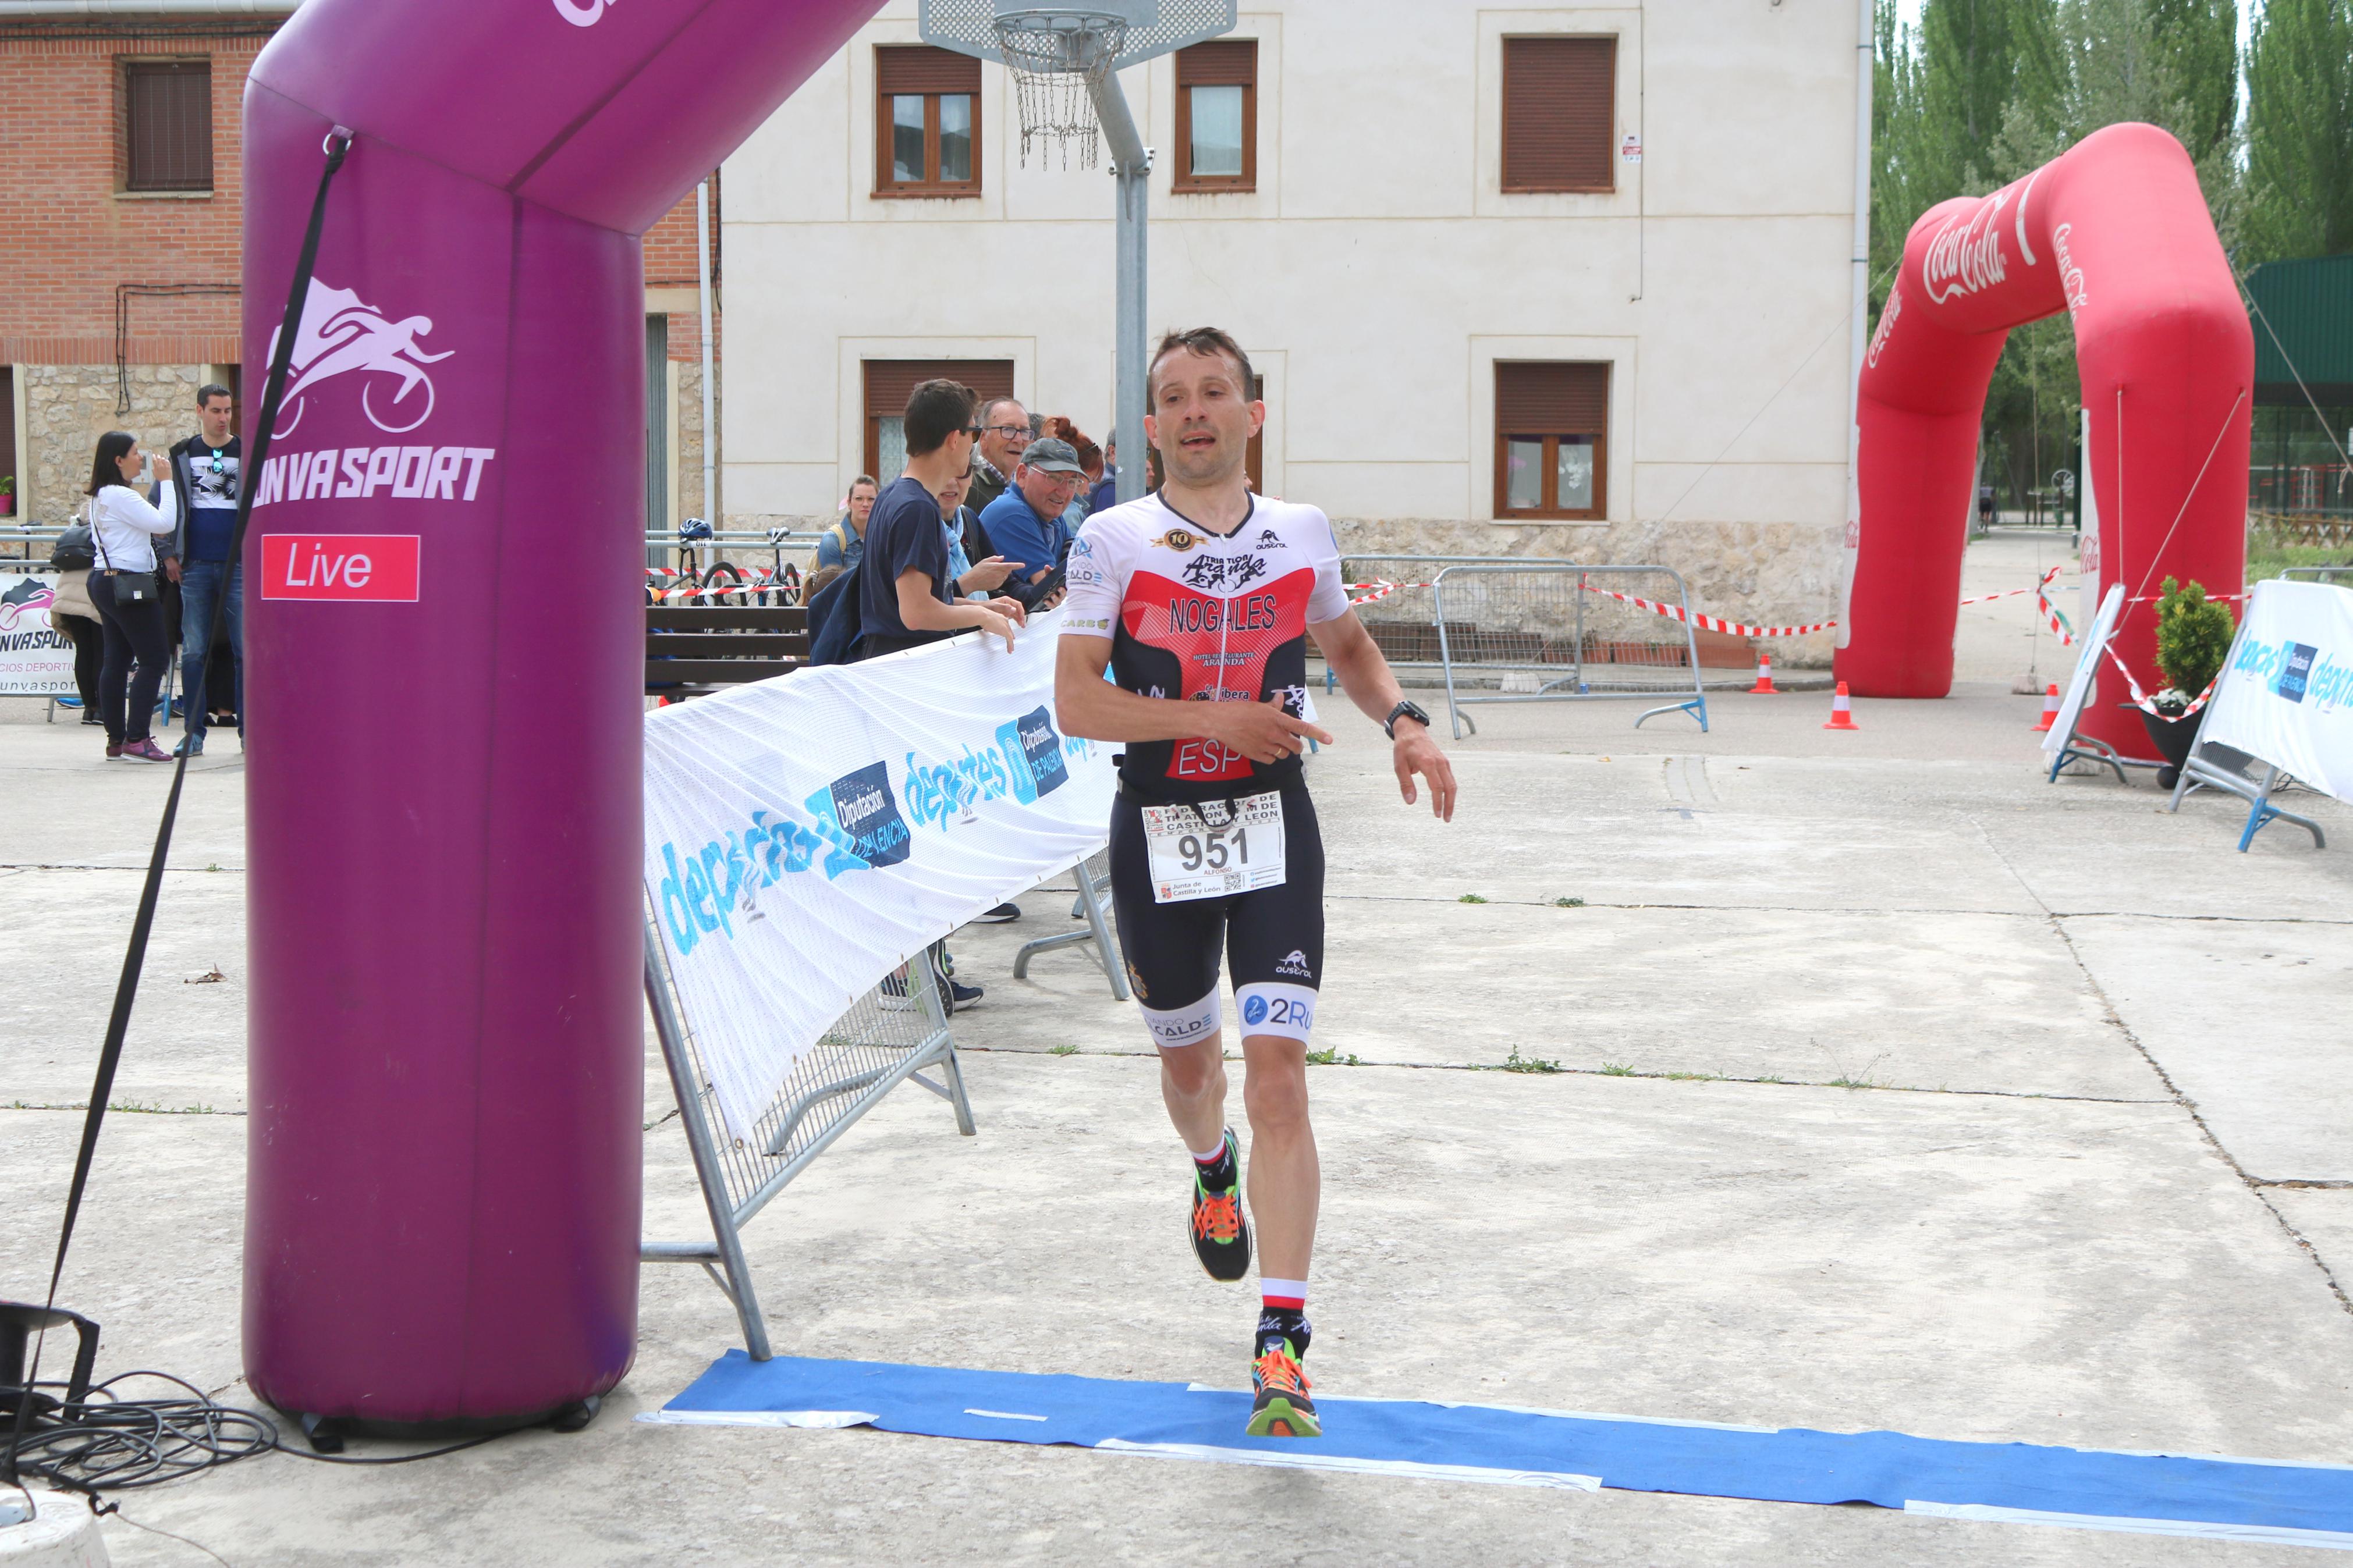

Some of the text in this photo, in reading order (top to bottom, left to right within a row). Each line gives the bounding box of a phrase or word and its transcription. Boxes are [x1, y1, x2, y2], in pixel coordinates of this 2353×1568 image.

[1171, 534, 1188, 545] 10
[286, 542, 372, 588] Live
[1182, 554, 1267, 578] Aranda
[1169, 594, 1276, 635] NOGALES
[26, 663, 75, 671] DEPORTIV
[1202, 659, 1245, 667] ARANDA
[0, 681, 75, 692] unvaspor
[1179, 739, 1241, 775] ESP
[1031, 759, 1044, 782] DE
[1259, 794, 1276, 802] DE
[837, 785, 885, 830] Diputación
[1261, 802, 1277, 810] DE
[1244, 810, 1278, 821] LEON
[1179, 828, 1248, 872] 951
[1204, 866, 1232, 875] ALFONSO
[1173, 888, 1197, 897] Castilla
[1276, 966, 1312, 979] austral
